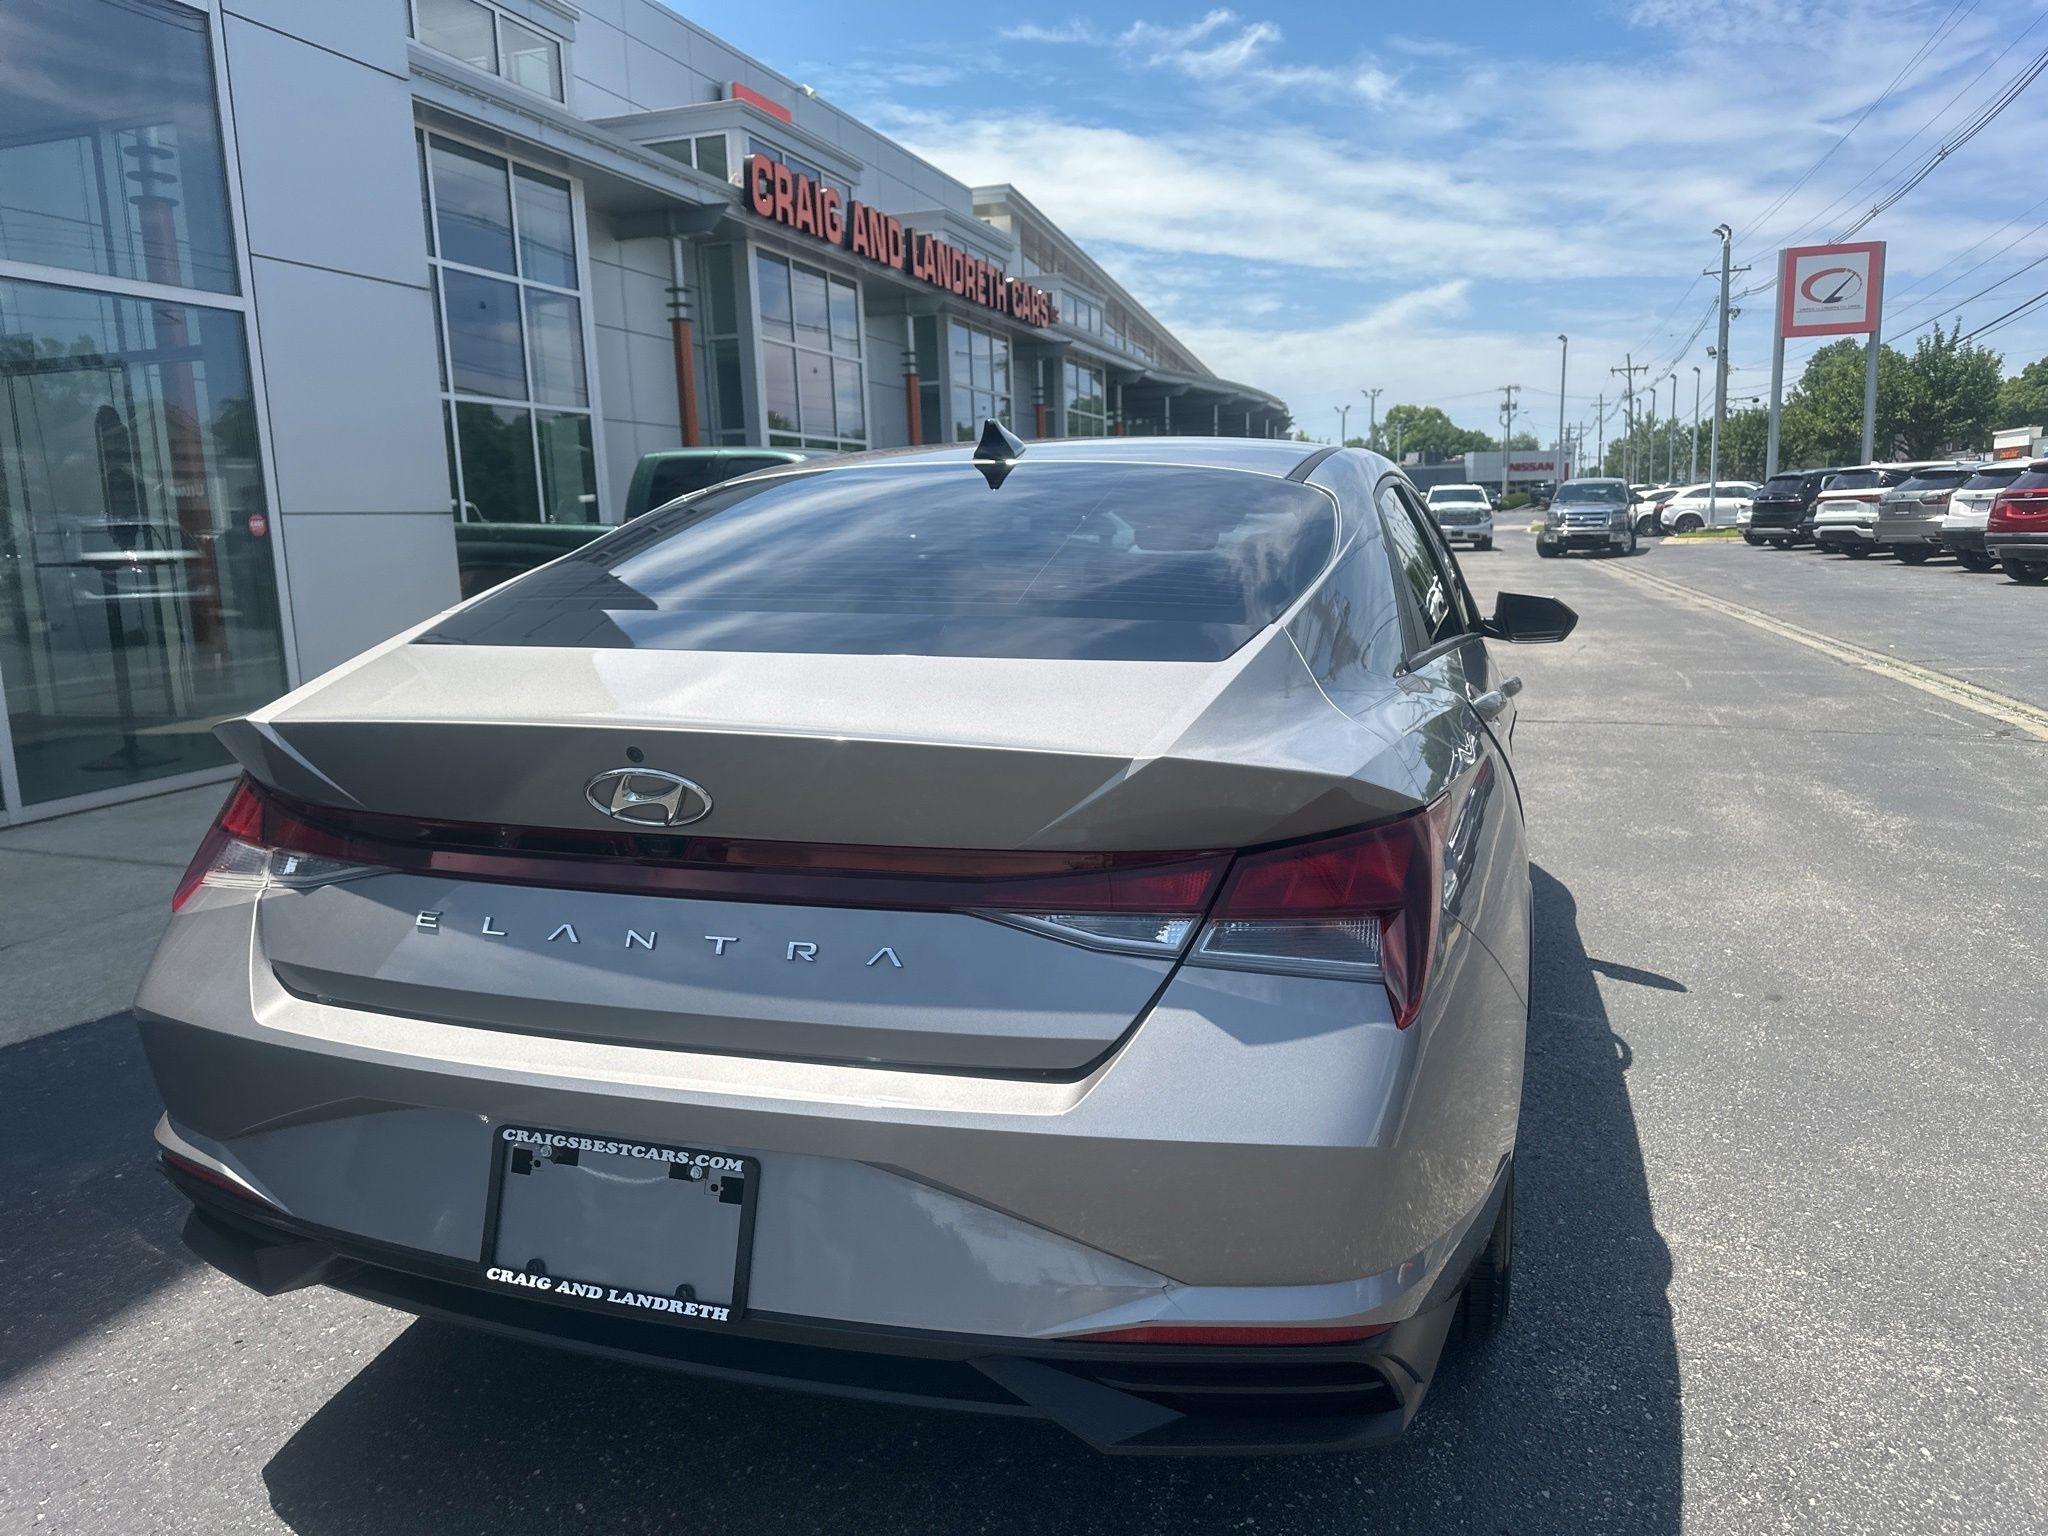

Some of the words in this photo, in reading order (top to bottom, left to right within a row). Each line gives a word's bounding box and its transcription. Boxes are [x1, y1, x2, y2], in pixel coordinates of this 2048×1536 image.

[750, 154, 843, 245] CRAIG
[853, 201, 902, 269] AND
[911, 229, 1007, 312] LANDRETH
[1012, 279, 1049, 328] CARS
[1508, 462, 1554, 472] NISSAN
[416, 910, 903, 968] ELANTRA
[502, 1128, 745, 1172] CRAIGSBESTCARS.COM
[486, 1267, 552, 1290] CRAIG
[555, 1279, 603, 1300] AND
[607, 1289, 730, 1322] LANDRETH
